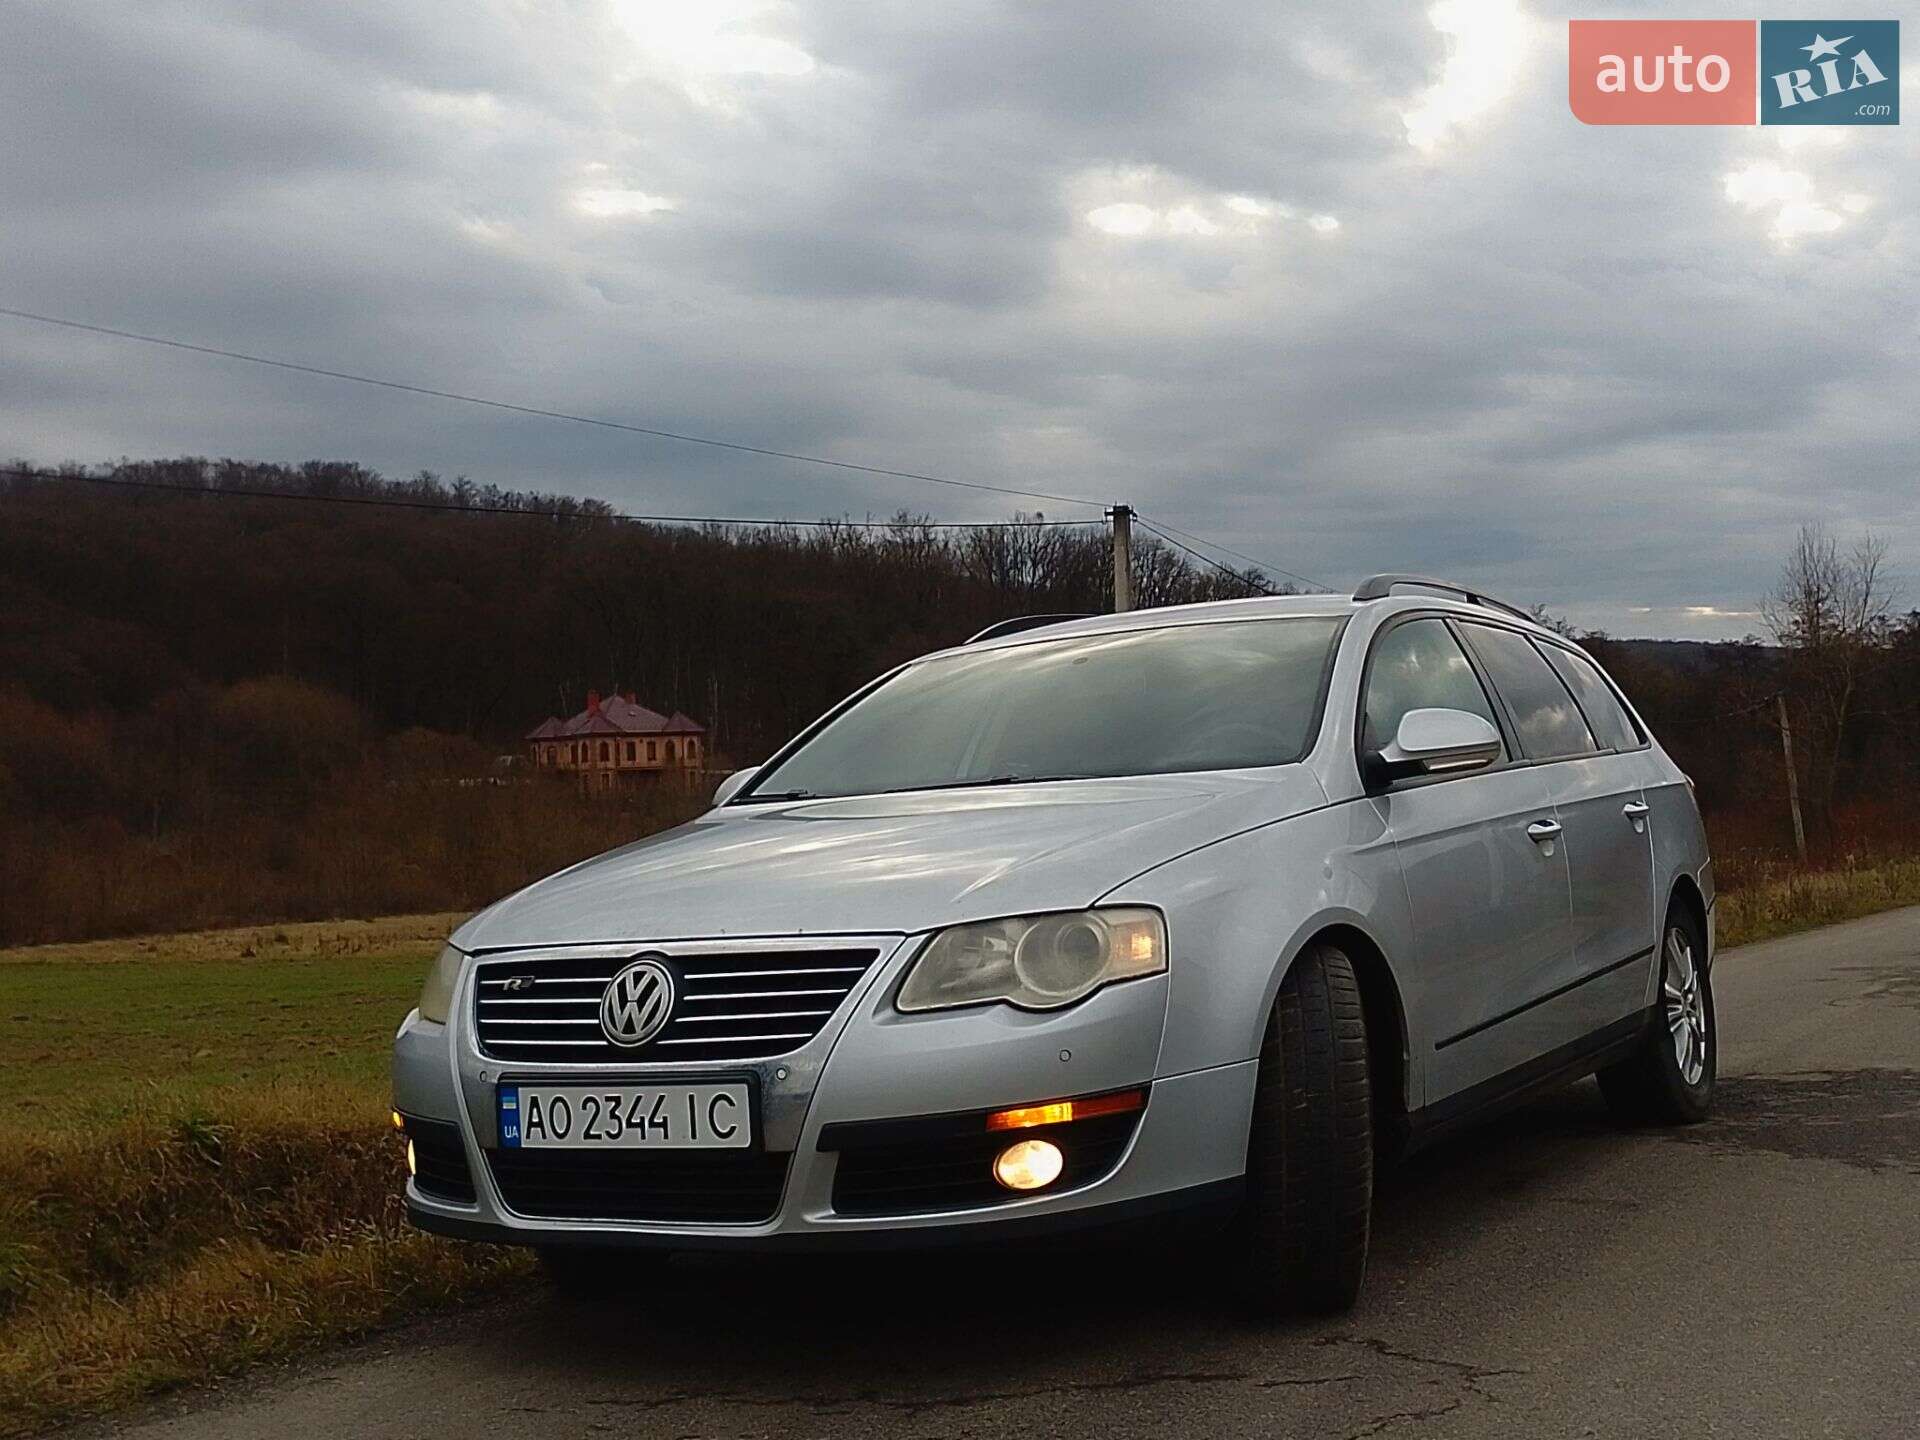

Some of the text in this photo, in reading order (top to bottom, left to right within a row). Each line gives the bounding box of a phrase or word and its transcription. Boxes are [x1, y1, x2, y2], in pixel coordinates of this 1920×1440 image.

[525, 1093, 737, 1140] AO 2344 IC
[504, 1126, 519, 1138] UA
